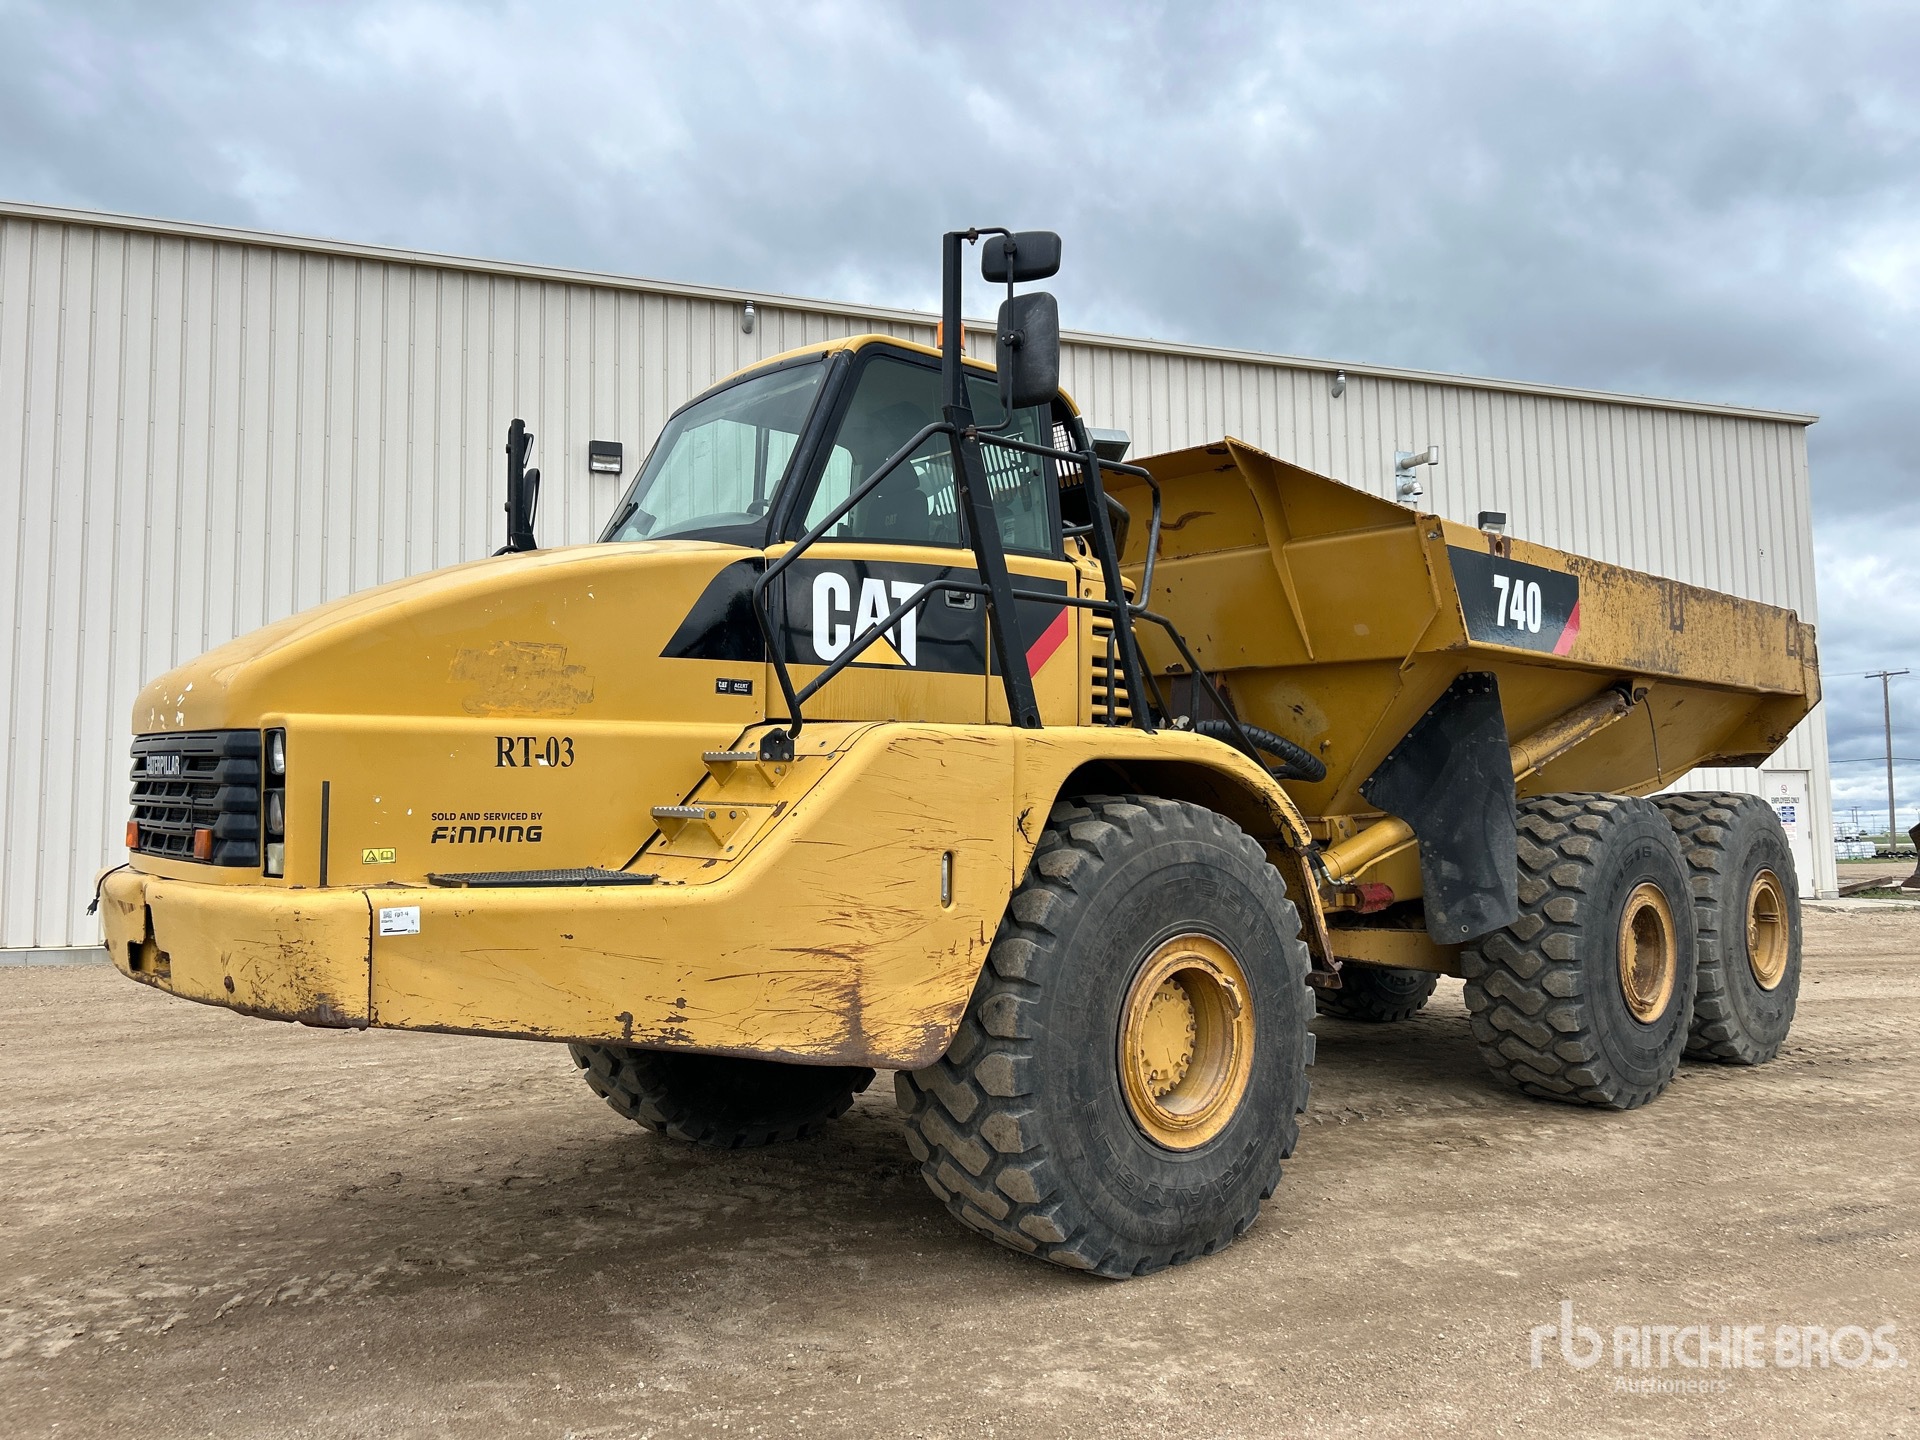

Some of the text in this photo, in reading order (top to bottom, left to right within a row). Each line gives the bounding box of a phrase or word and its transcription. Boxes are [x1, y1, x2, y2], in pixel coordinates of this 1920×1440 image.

[812, 571, 924, 667] CAT
[1493, 574, 1541, 633] 740
[494, 736, 575, 768] RT-03
[431, 812, 543, 821] SOLD AND SERVICED BY
